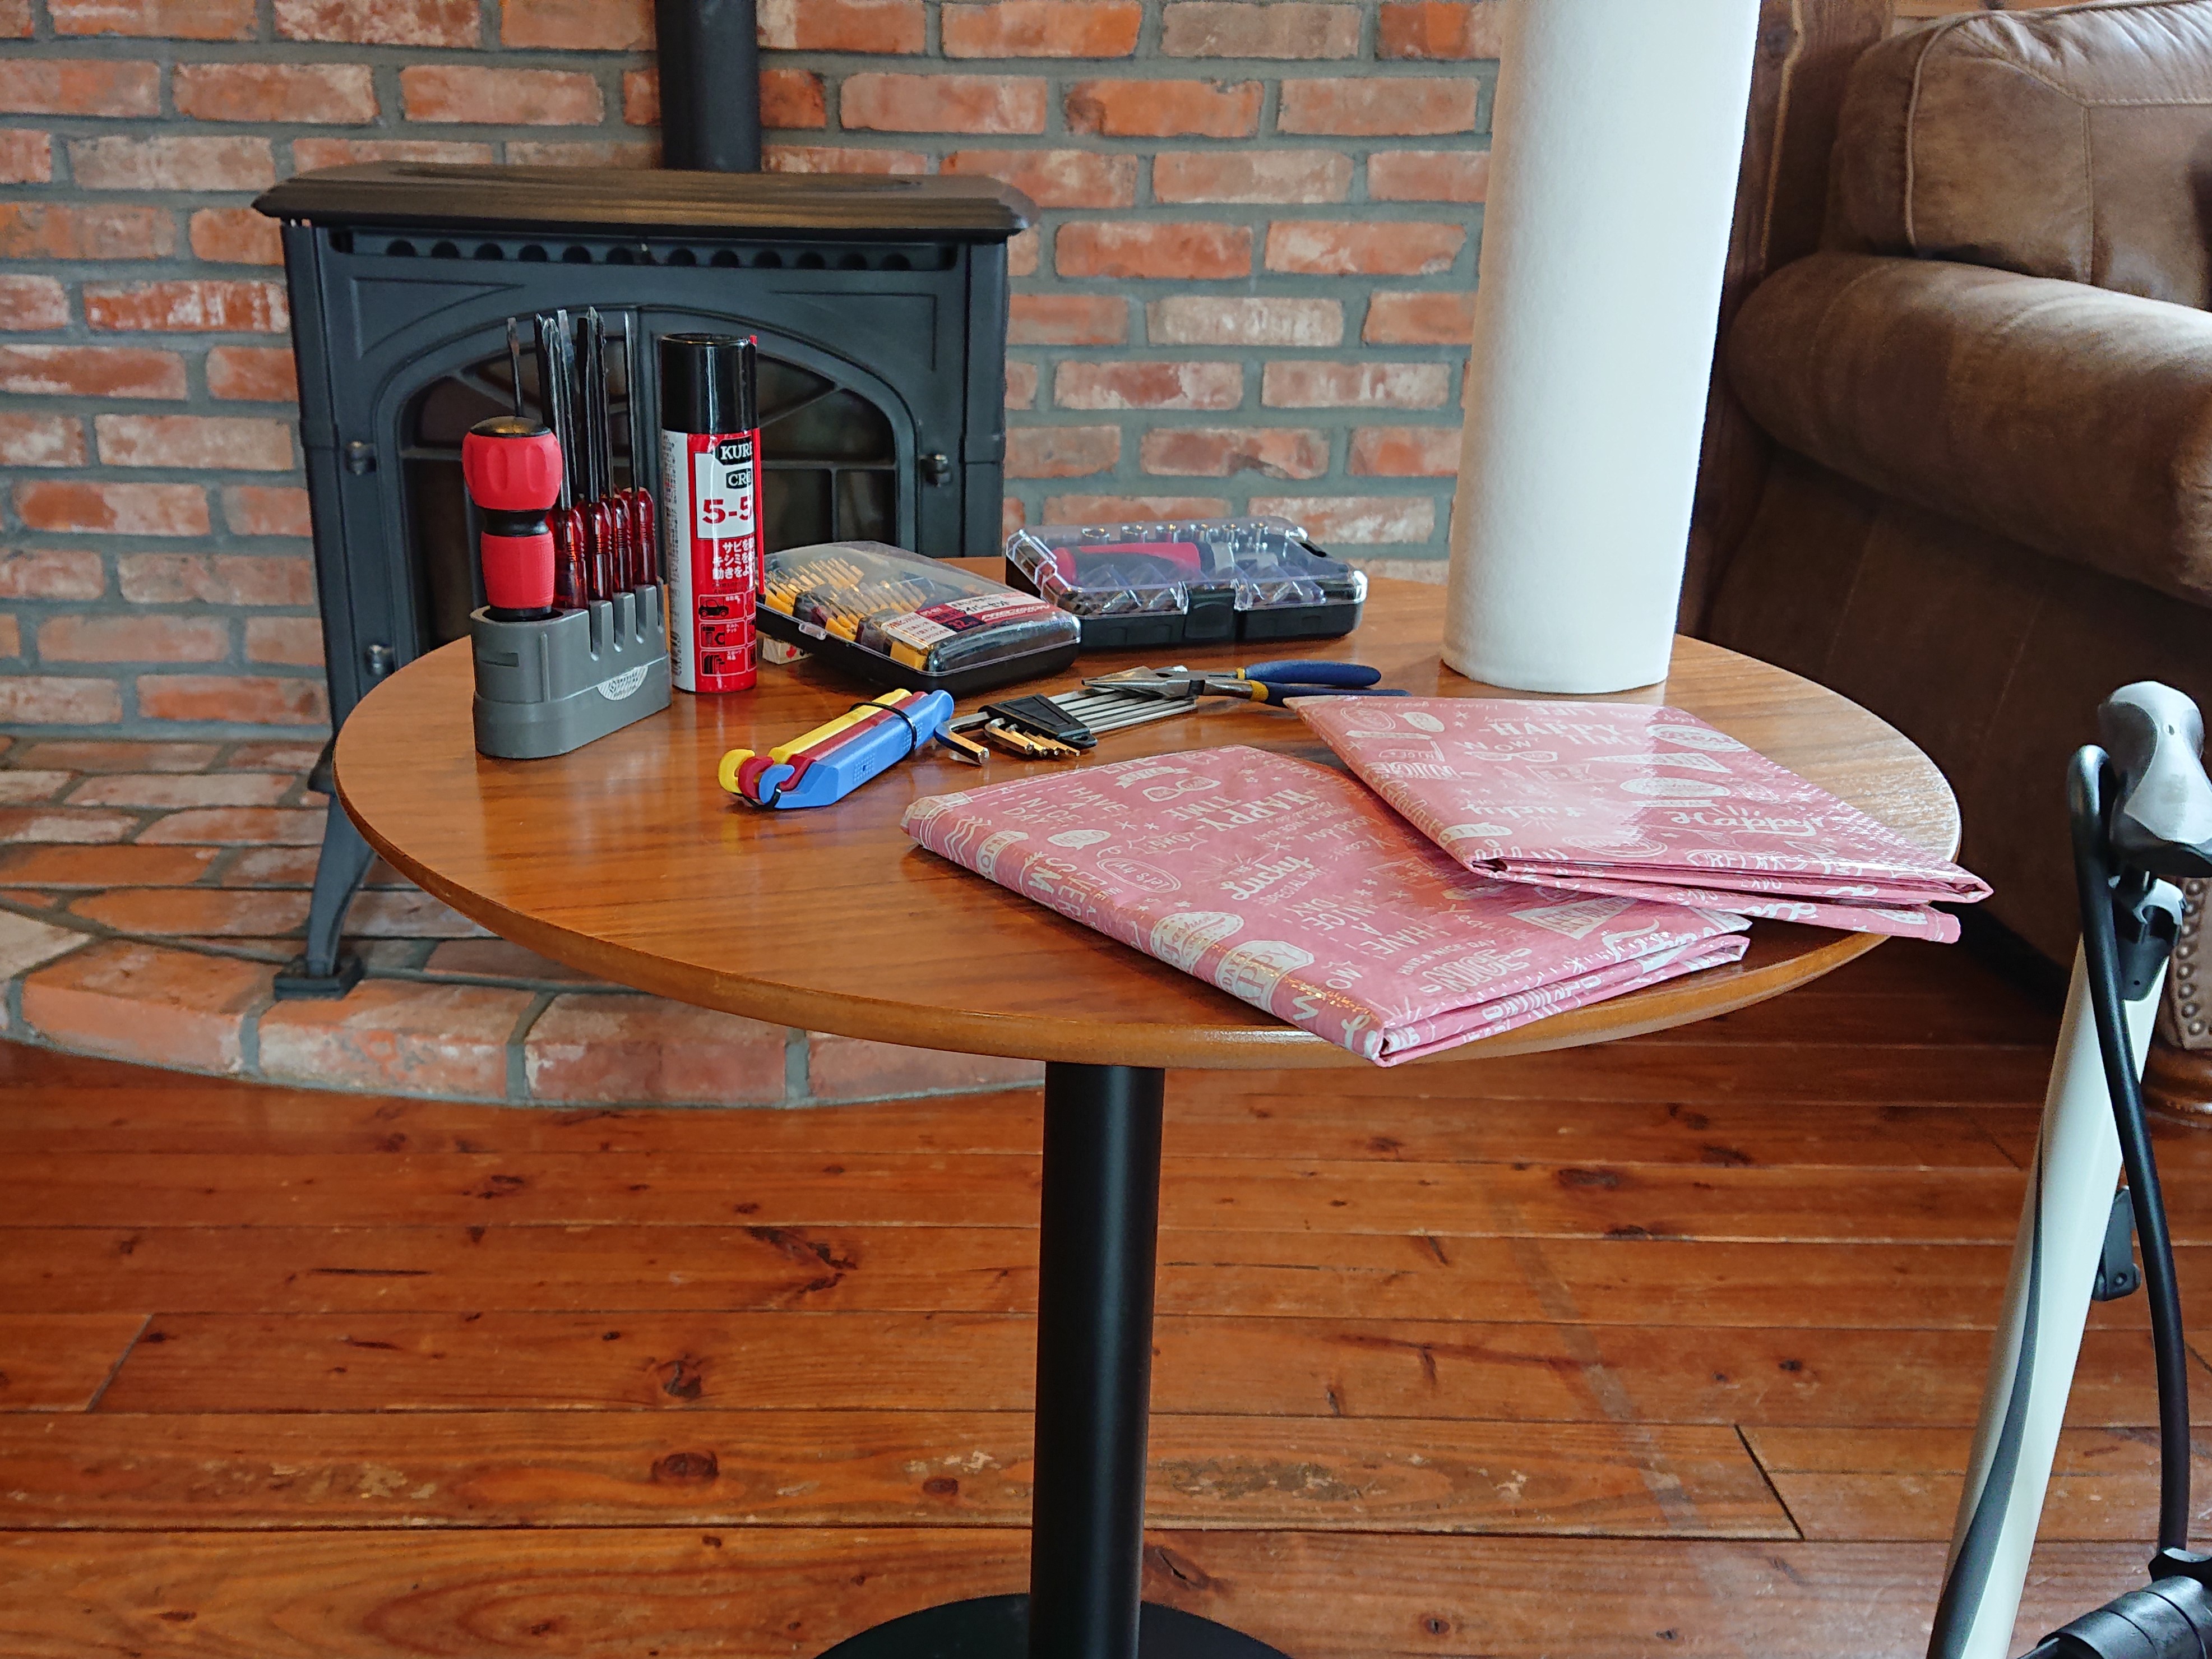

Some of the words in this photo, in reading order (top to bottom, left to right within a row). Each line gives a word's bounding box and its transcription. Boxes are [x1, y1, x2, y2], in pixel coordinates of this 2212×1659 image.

[728, 471, 751, 486] CRC
[982, 604, 1050, 621] PRECISION
[1020, 797, 1082, 823] NICE
[1061, 802, 1087, 810] A
[1067, 787, 1128, 812] HAVE
[1161, 795, 1241, 821] TIME
[1197, 789, 1319, 831] HAPPY
[1002, 807, 1050, 825] DAY
[1220, 857, 1314, 900] Lucky
[1298, 868, 1326, 880] DAY
[1285, 898, 1339, 917] DAY
[1301, 905, 1375, 931] NICE
[1351, 922, 1383, 936] A
[1359, 924, 1435, 954] HAVE
[1397, 958, 1426, 976] HAVE
[1420, 953, 1433, 962] A
[1431, 943, 1466, 958] NICE
[1466, 938, 1497, 949] DAY
